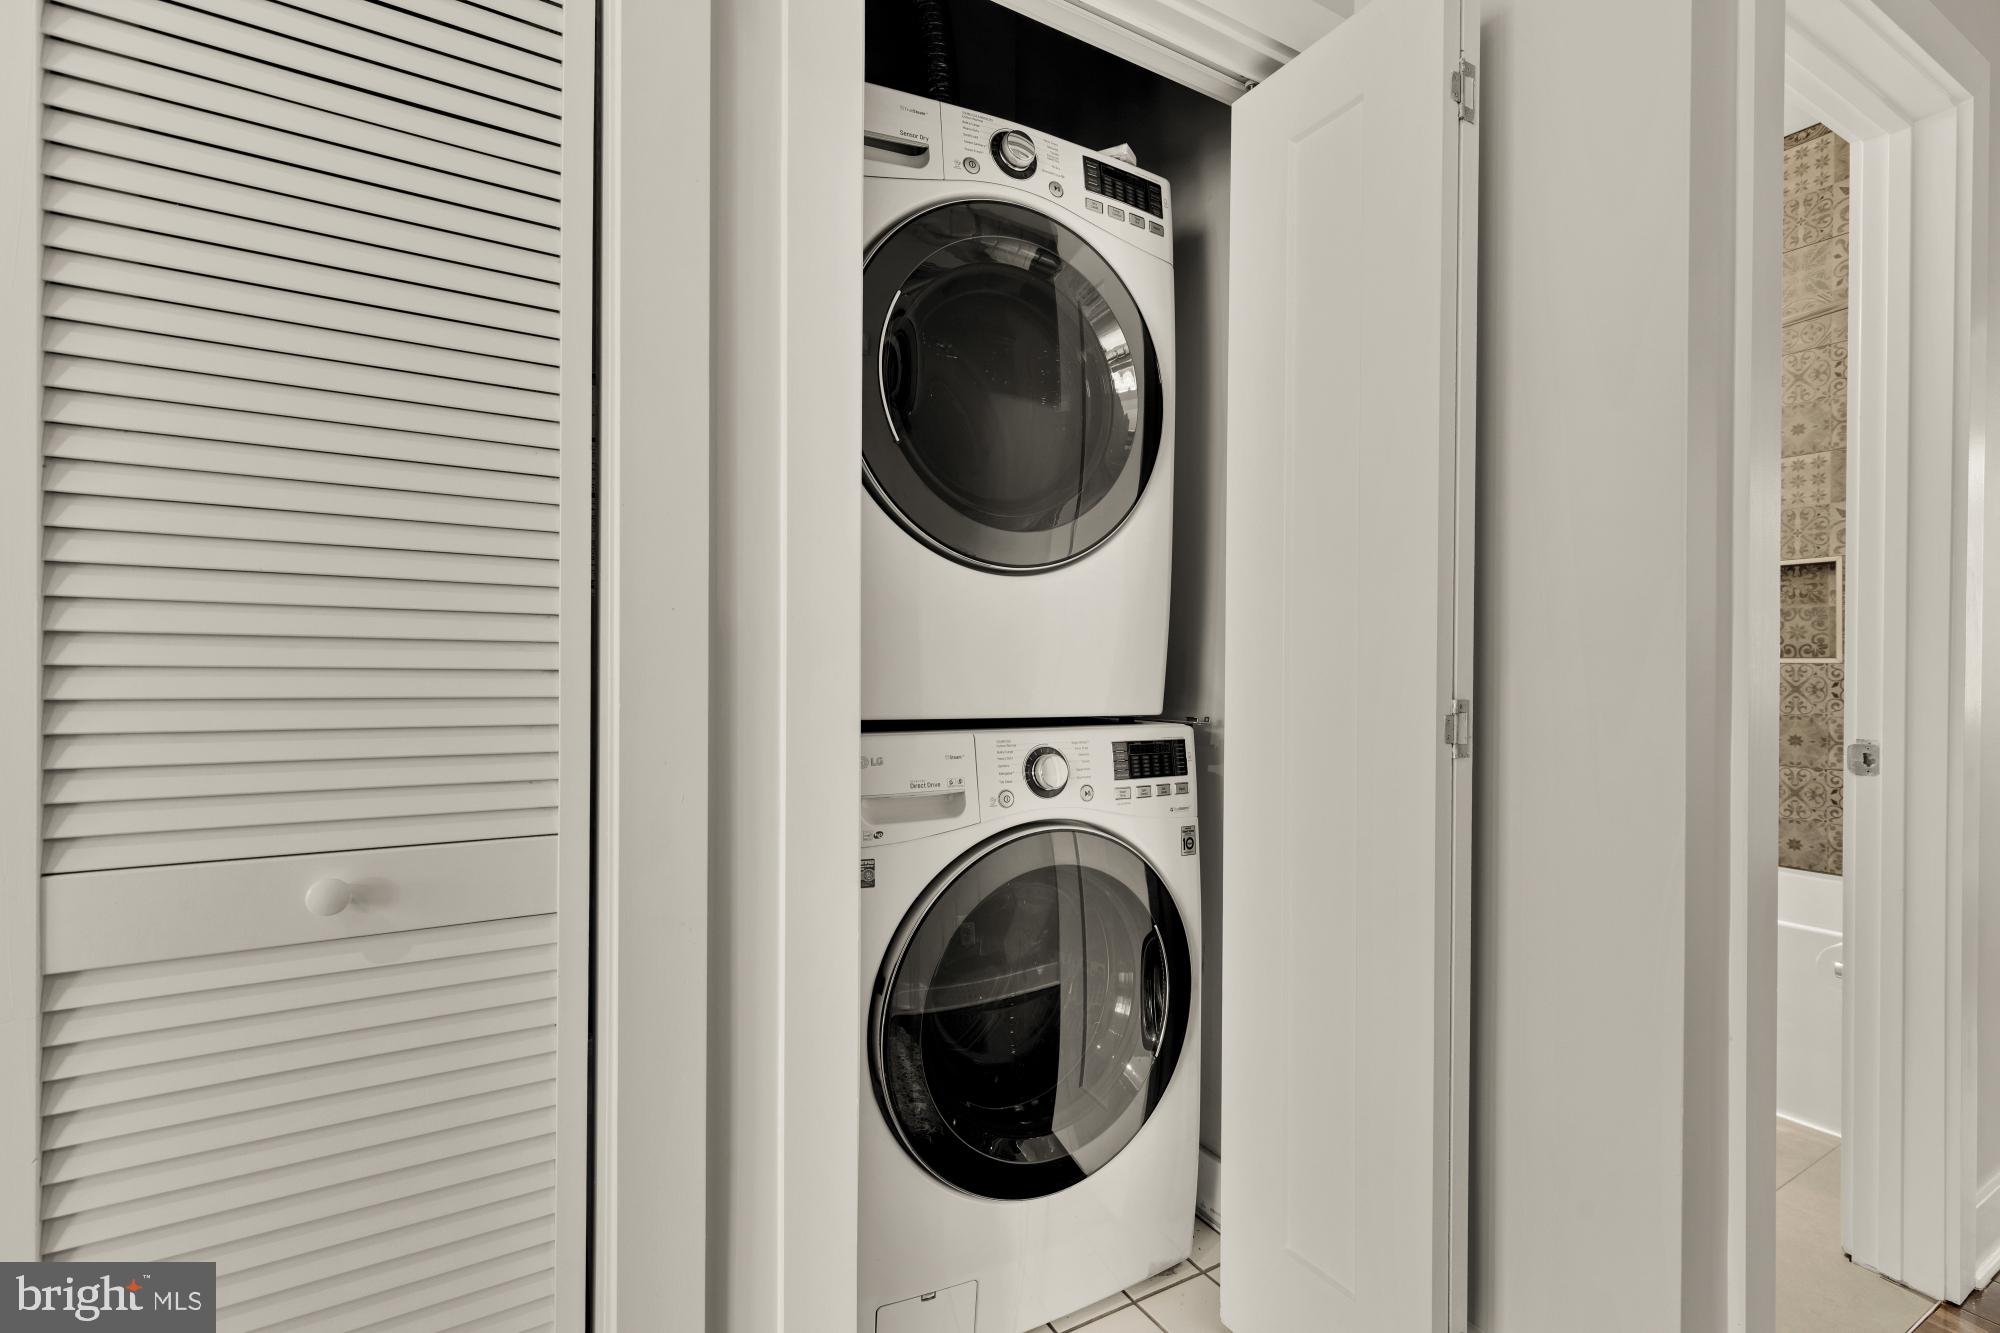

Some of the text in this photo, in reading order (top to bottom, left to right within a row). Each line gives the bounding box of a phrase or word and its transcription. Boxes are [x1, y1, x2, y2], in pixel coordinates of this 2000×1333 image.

[899, 129, 929, 142] Sensor Dry
[870, 756, 884, 767] LG
[926, 781, 941, 789] Drive
[1182, 836, 1195, 851] 10
